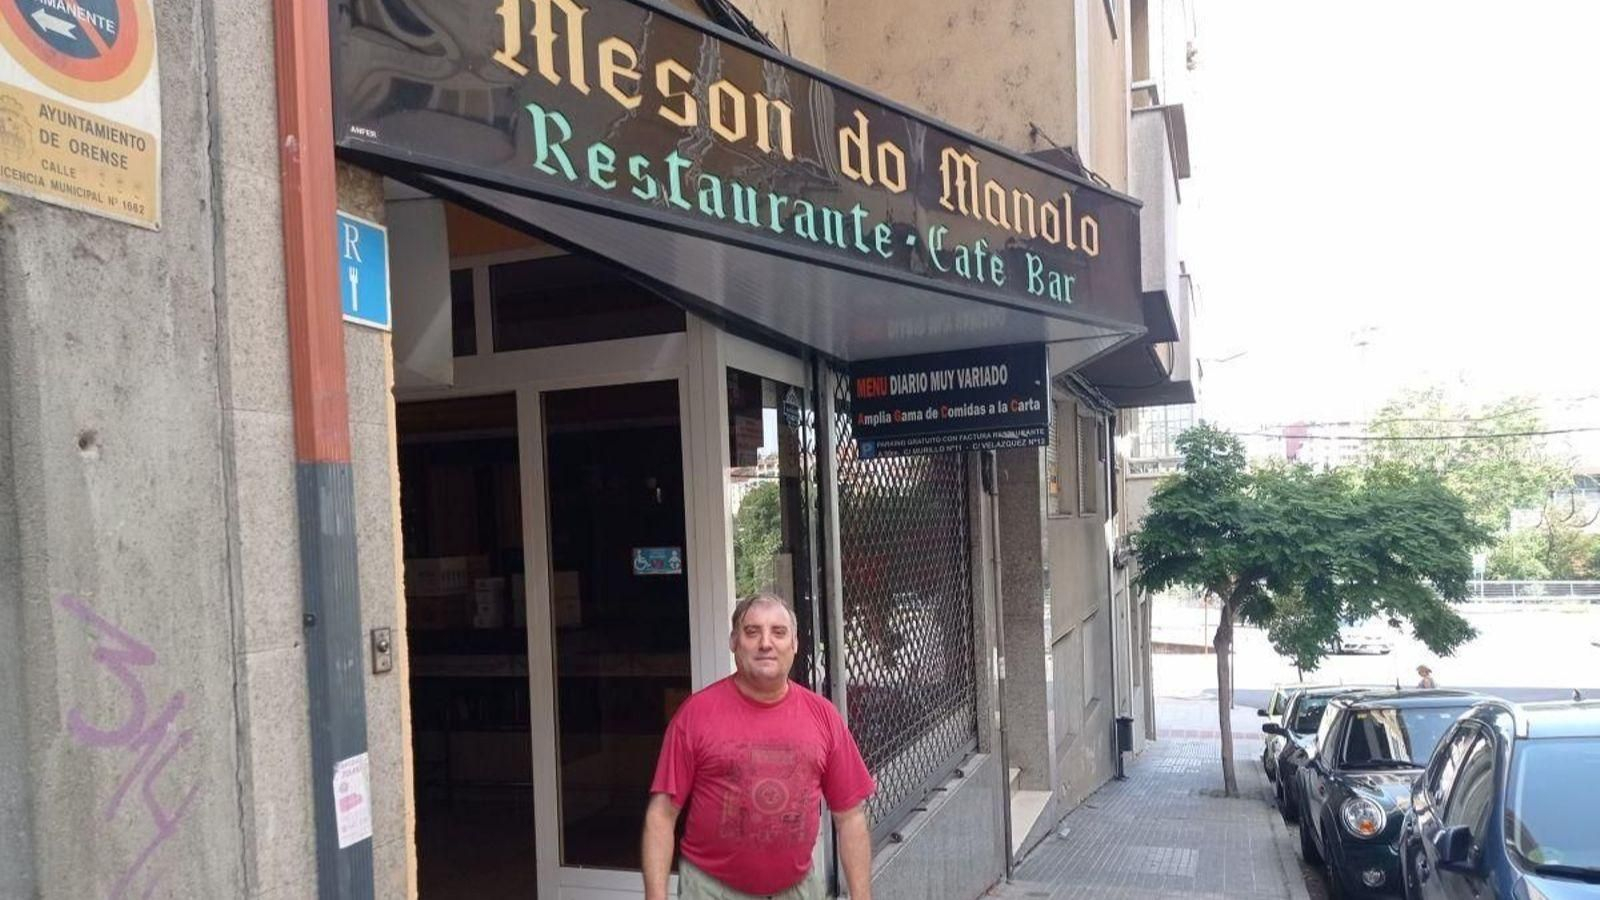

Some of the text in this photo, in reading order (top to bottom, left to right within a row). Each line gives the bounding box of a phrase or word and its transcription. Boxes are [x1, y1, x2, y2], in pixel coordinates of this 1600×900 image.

[39, 103, 147, 153] AYUNTAMIENTO
[493, 0, 1099, 257] Meson do Manolo
[39, 128, 129, 171] DE ORENSE
[41, 158, 78, 179] CALLE
[50, 179, 104, 204] MUNICIPAL
[525, 102, 894, 259] Restaurante
[1026, 251, 1077, 304] Bar
[343, 222, 362, 263] R
[856, 363, 1008, 398] MENU DIARIO MUY VARIADO
[857, 396, 1041, 428] Amplia Gama de Comidas a la Carta
